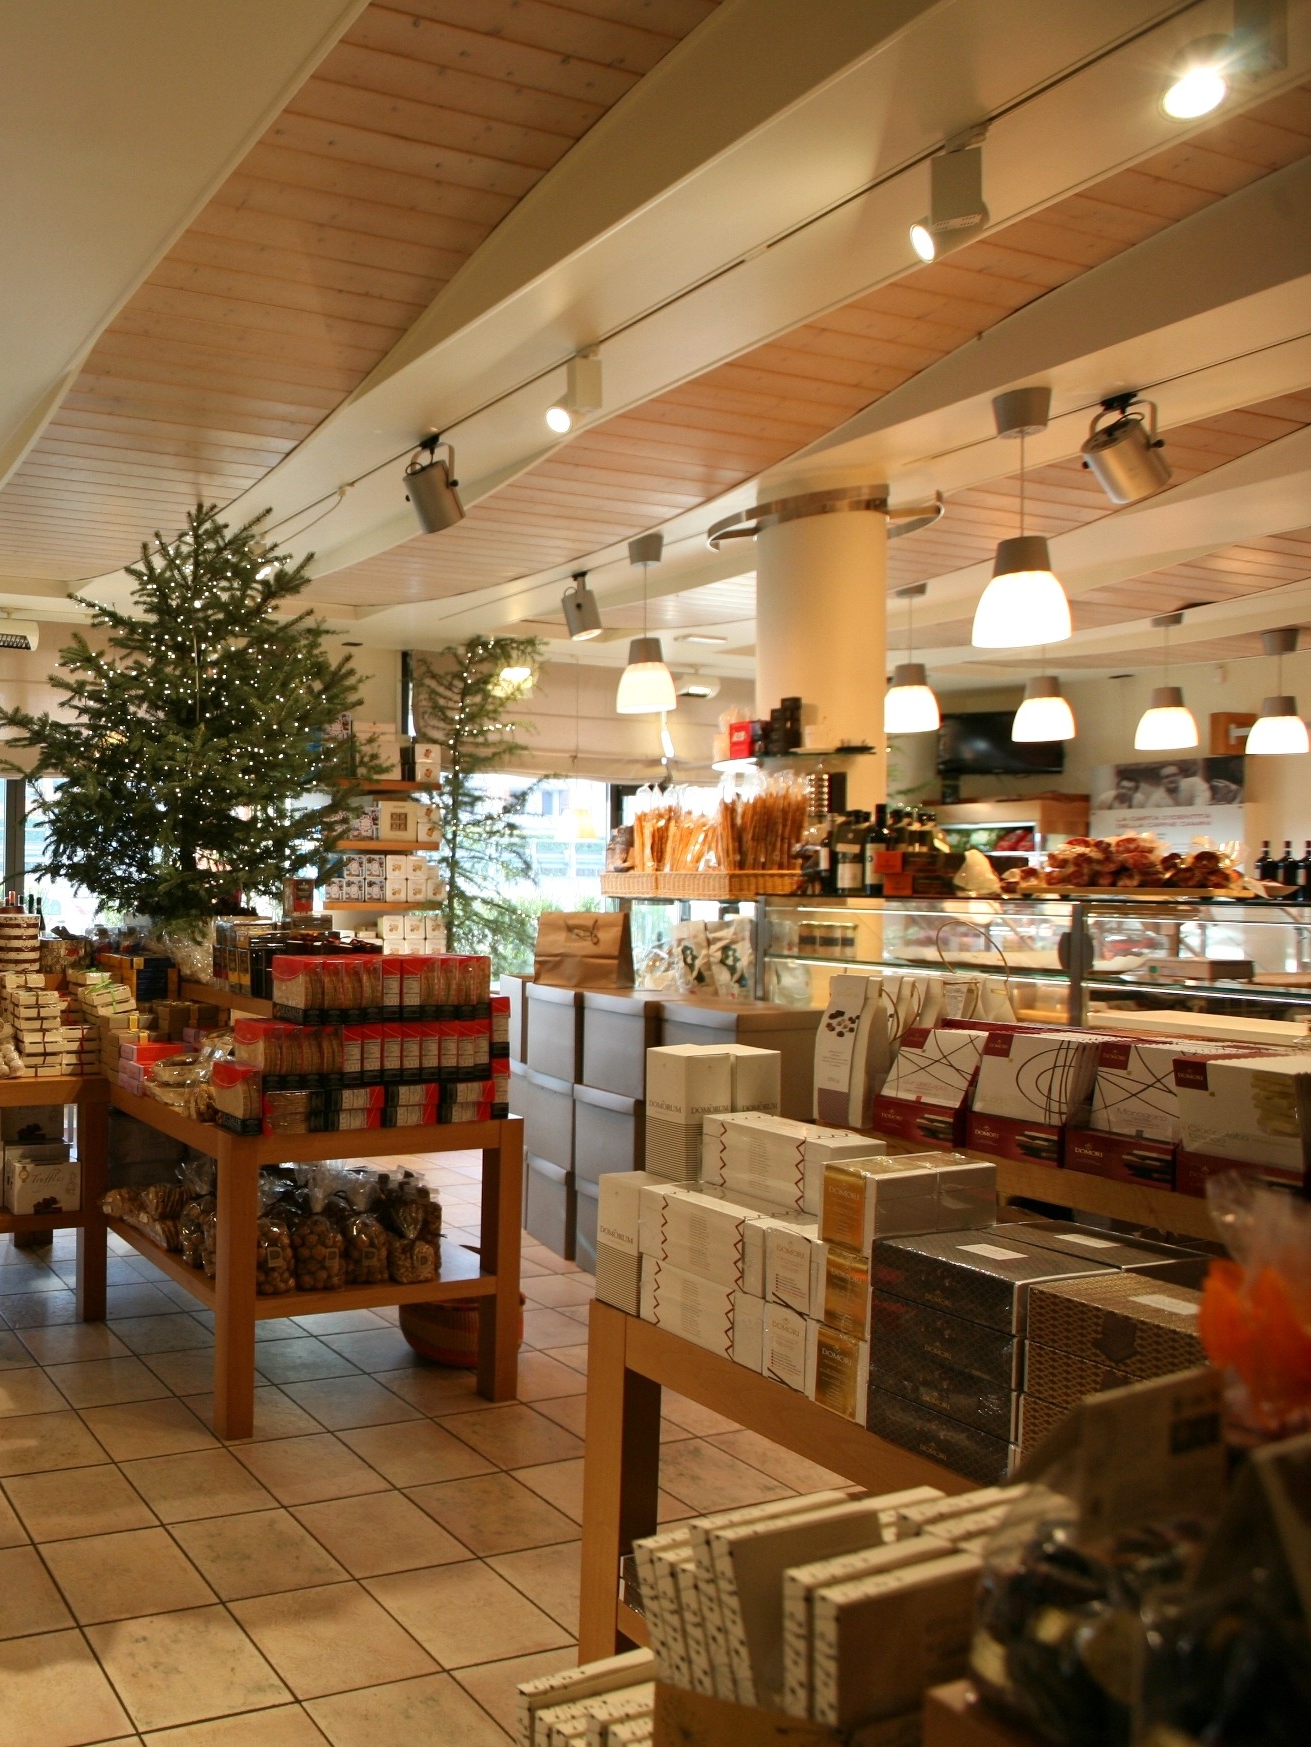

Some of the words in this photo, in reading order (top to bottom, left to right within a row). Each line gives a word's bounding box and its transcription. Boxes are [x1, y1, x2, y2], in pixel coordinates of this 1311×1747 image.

[1178, 1072, 1203, 1081] DOMORI
[974, 1129, 999, 1139] DOMORI
[1074, 1147, 1103, 1157] DOMORI
[32, 1167, 66, 1184] Truffles
[828, 1186, 860, 1201] DOMORI
[776, 1244, 804, 1259] DOMORI
[831, 1269, 862, 1284] DOMORI
[772, 1321, 800, 1337] DOMORI
[822, 1347, 852, 1366] DOMORI
